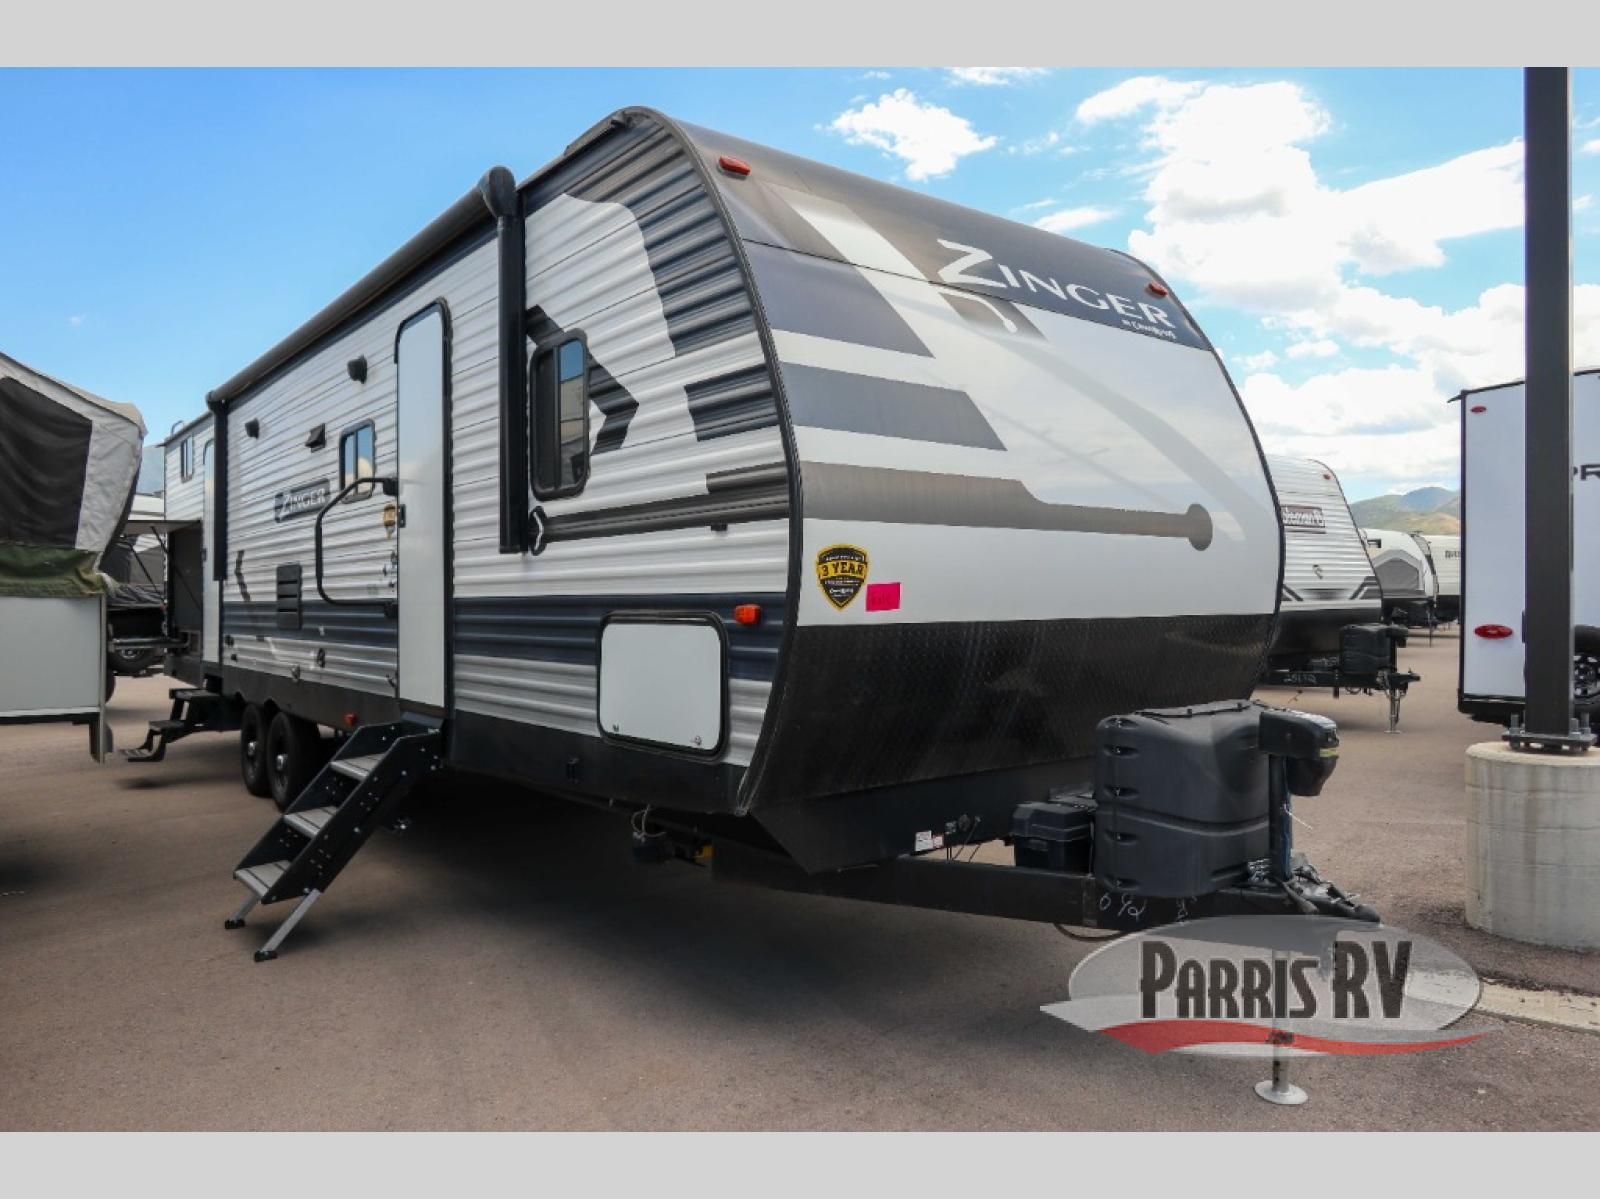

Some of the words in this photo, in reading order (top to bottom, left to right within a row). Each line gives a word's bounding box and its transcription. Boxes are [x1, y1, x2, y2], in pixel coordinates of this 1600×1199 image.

[937, 239, 1176, 328] ZINGER
[821, 564, 829, 577] 3
[832, 561, 864, 576] YEAR
